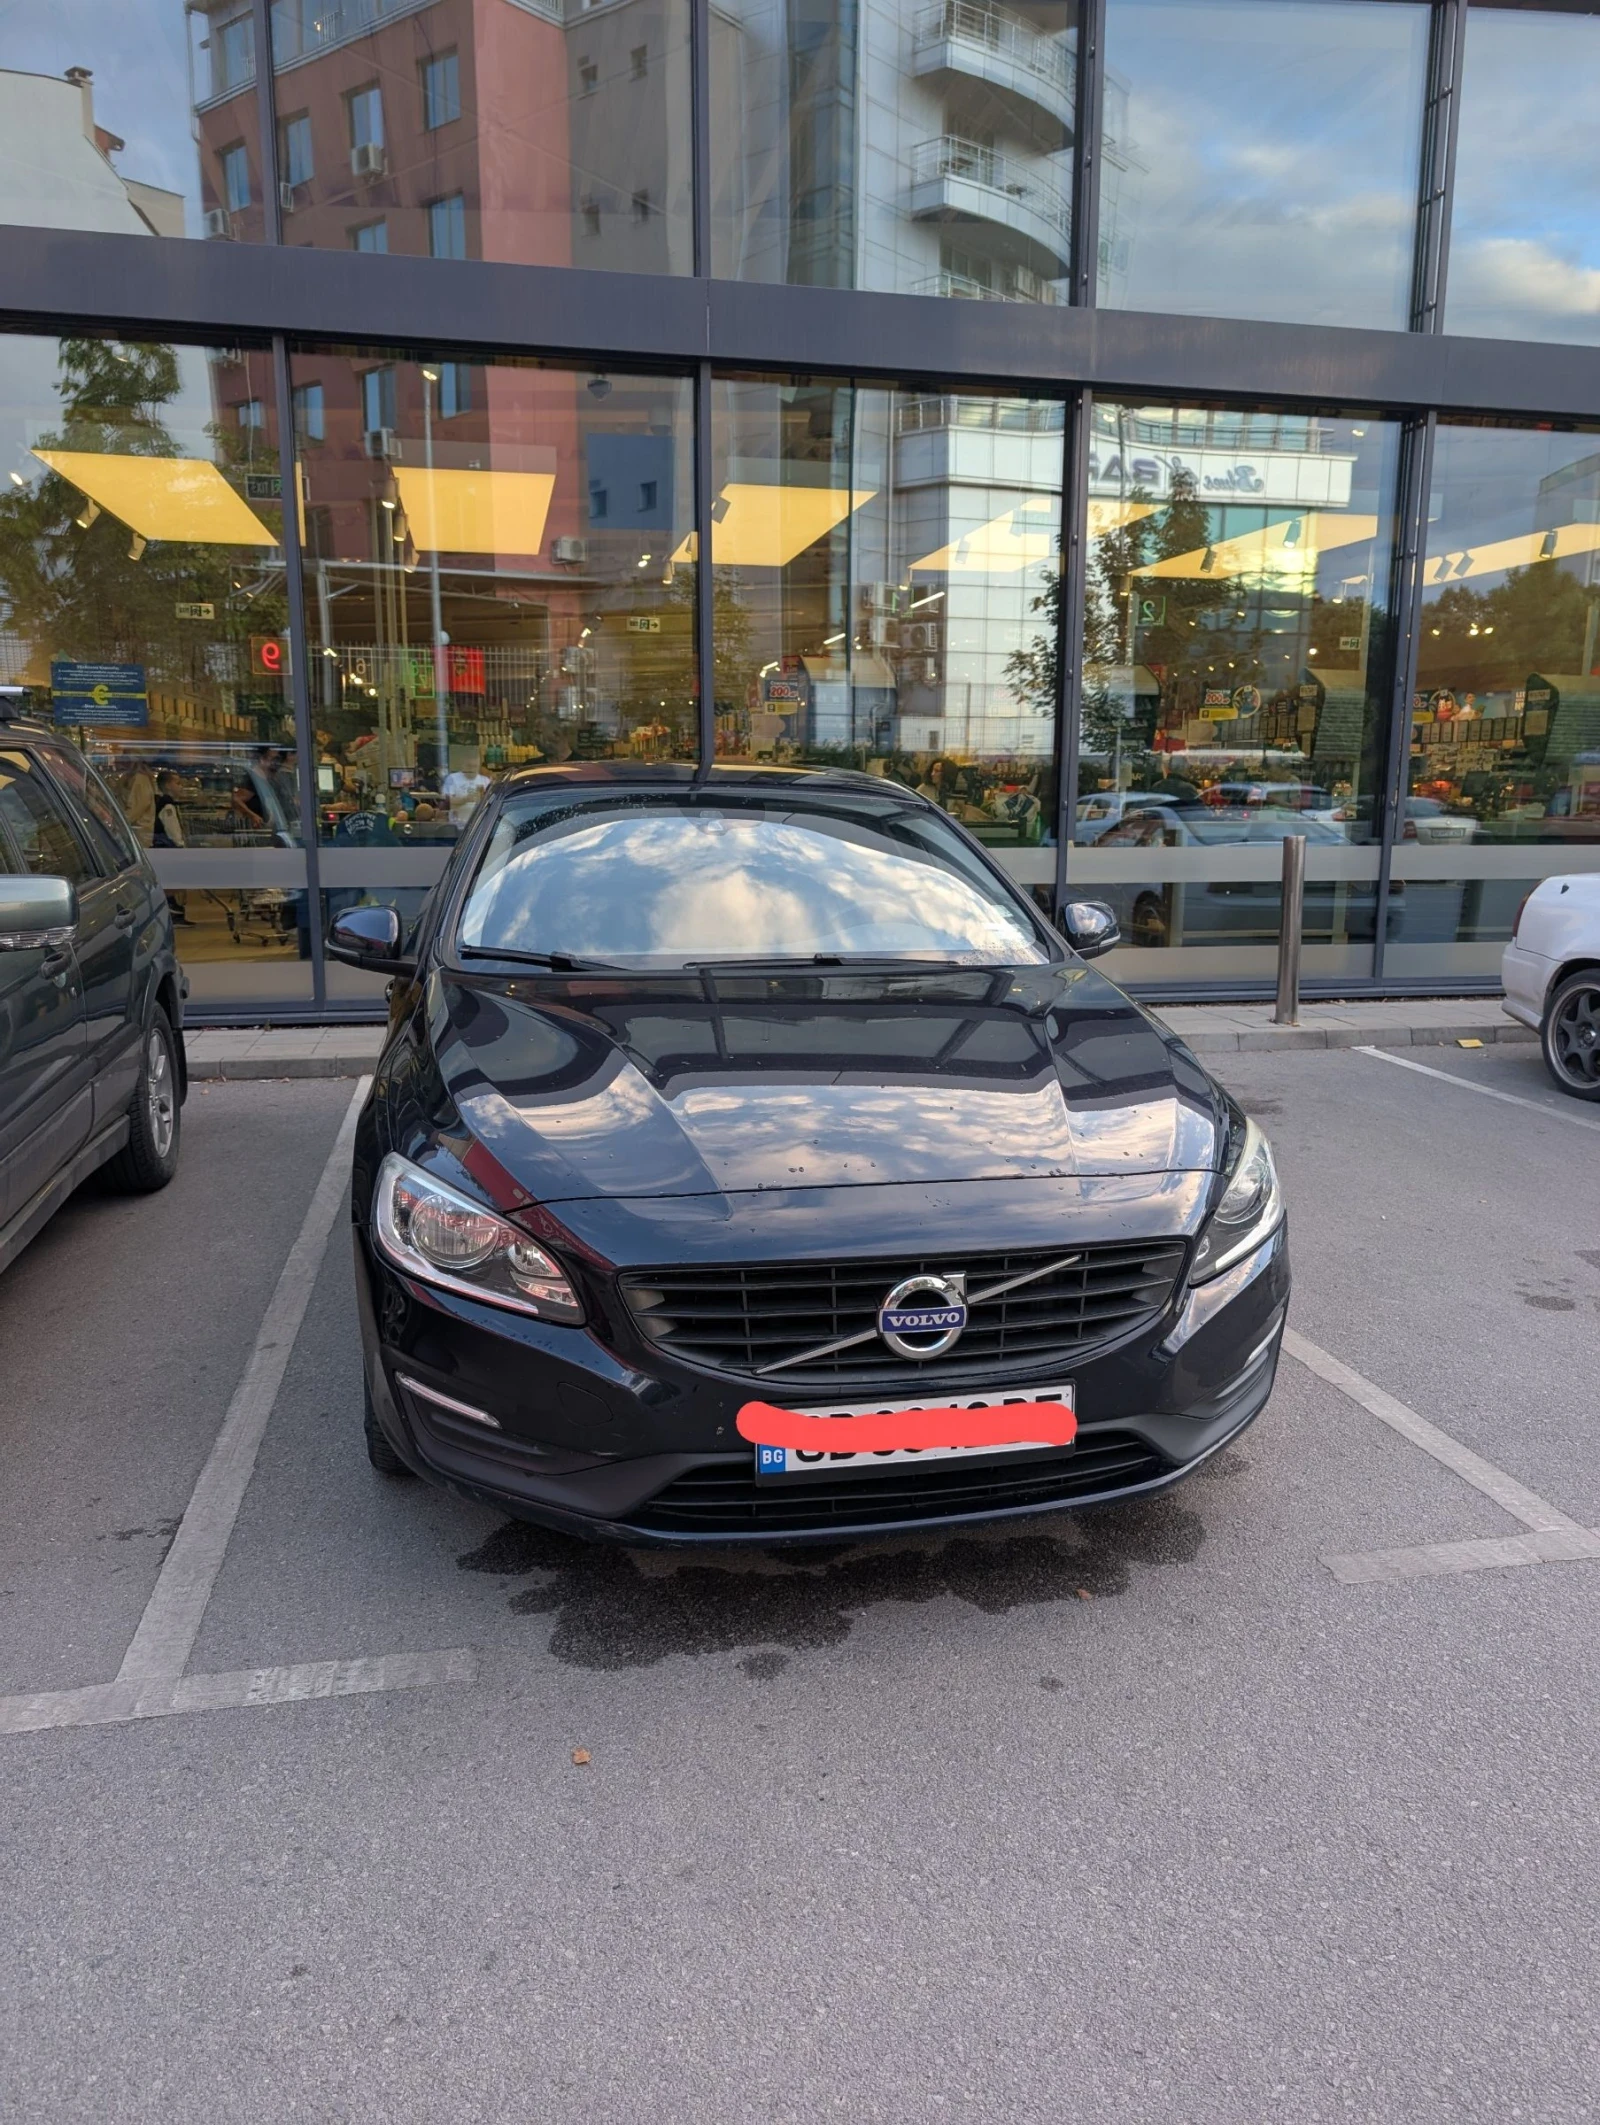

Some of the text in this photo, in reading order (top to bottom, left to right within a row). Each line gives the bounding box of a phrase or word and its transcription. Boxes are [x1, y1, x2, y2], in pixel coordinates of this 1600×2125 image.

[770, 686, 790, 698] 200
[886, 1311, 960, 1327] VOLVO
[762, 1448, 784, 1465] BG
